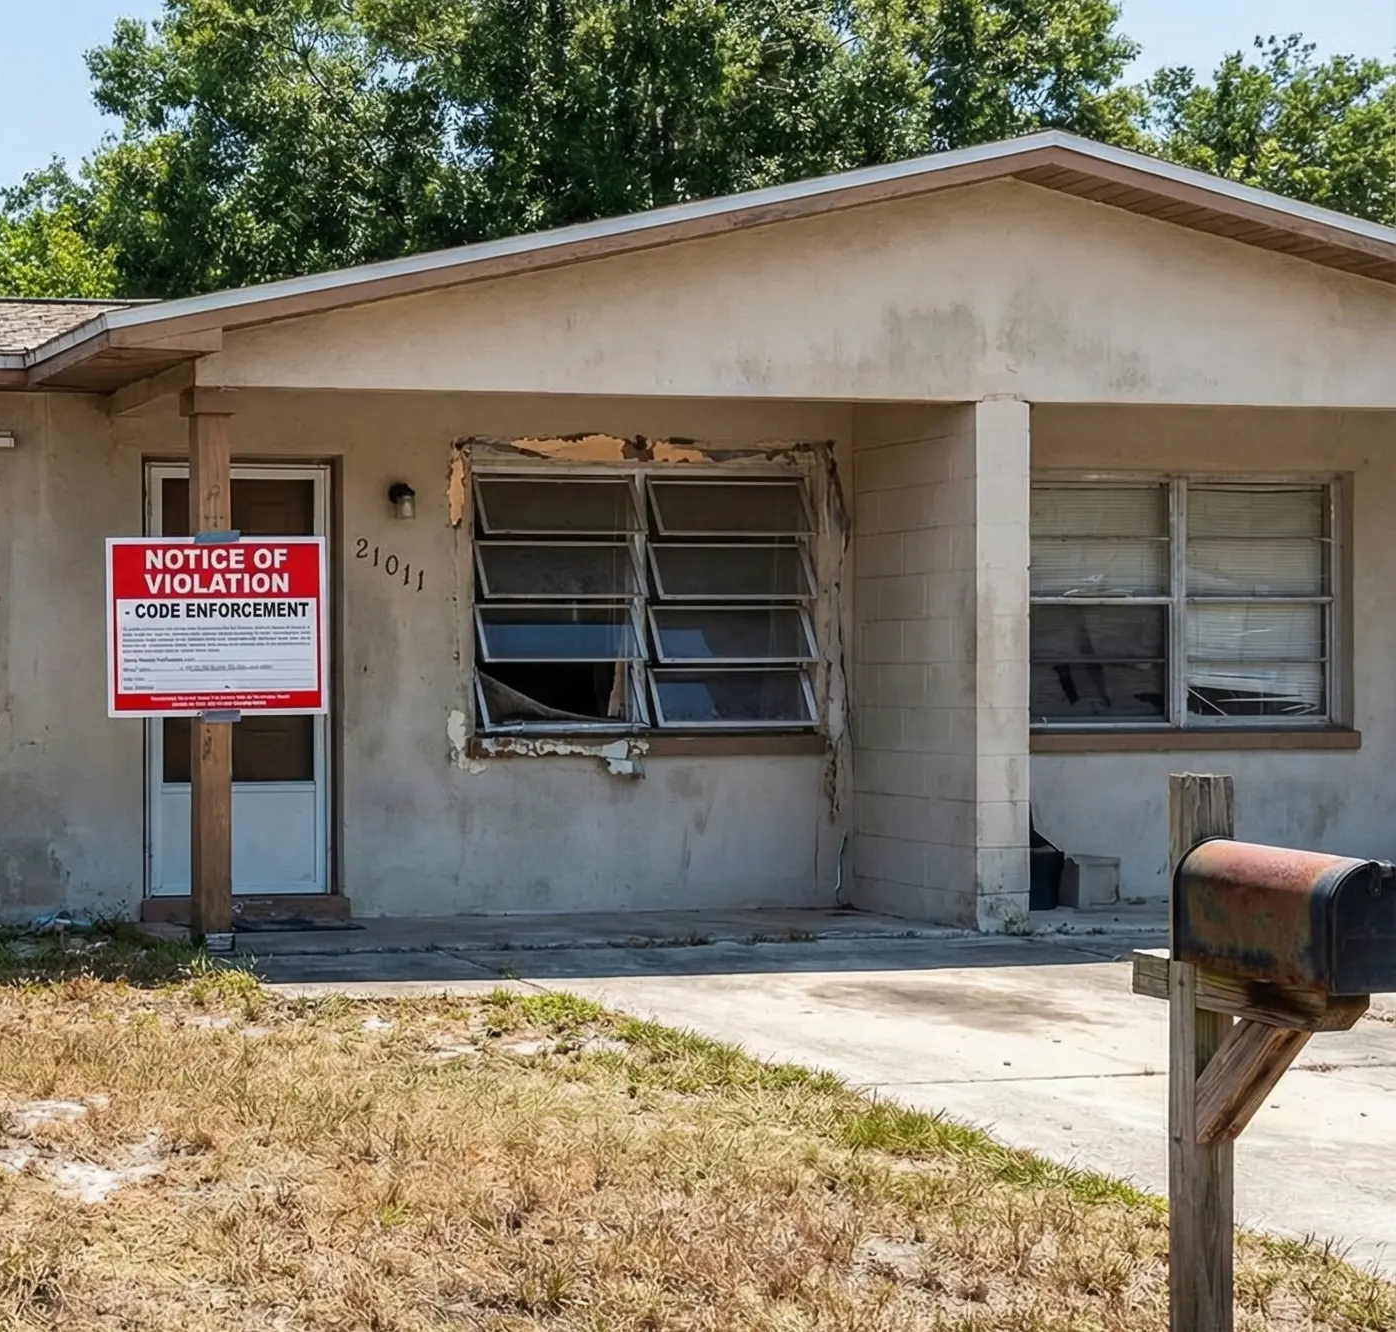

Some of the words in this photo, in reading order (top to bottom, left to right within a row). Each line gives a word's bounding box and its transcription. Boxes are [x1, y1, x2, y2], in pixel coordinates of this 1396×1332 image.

[144, 548, 245, 570] NOTICE
[253, 548, 288, 570] OF
[355, 537, 424, 592] 21011
[144, 572, 289, 594] VIOLATION
[134, 602, 181, 618] CODE
[185, 602, 309, 618] ENFORCEMENT
